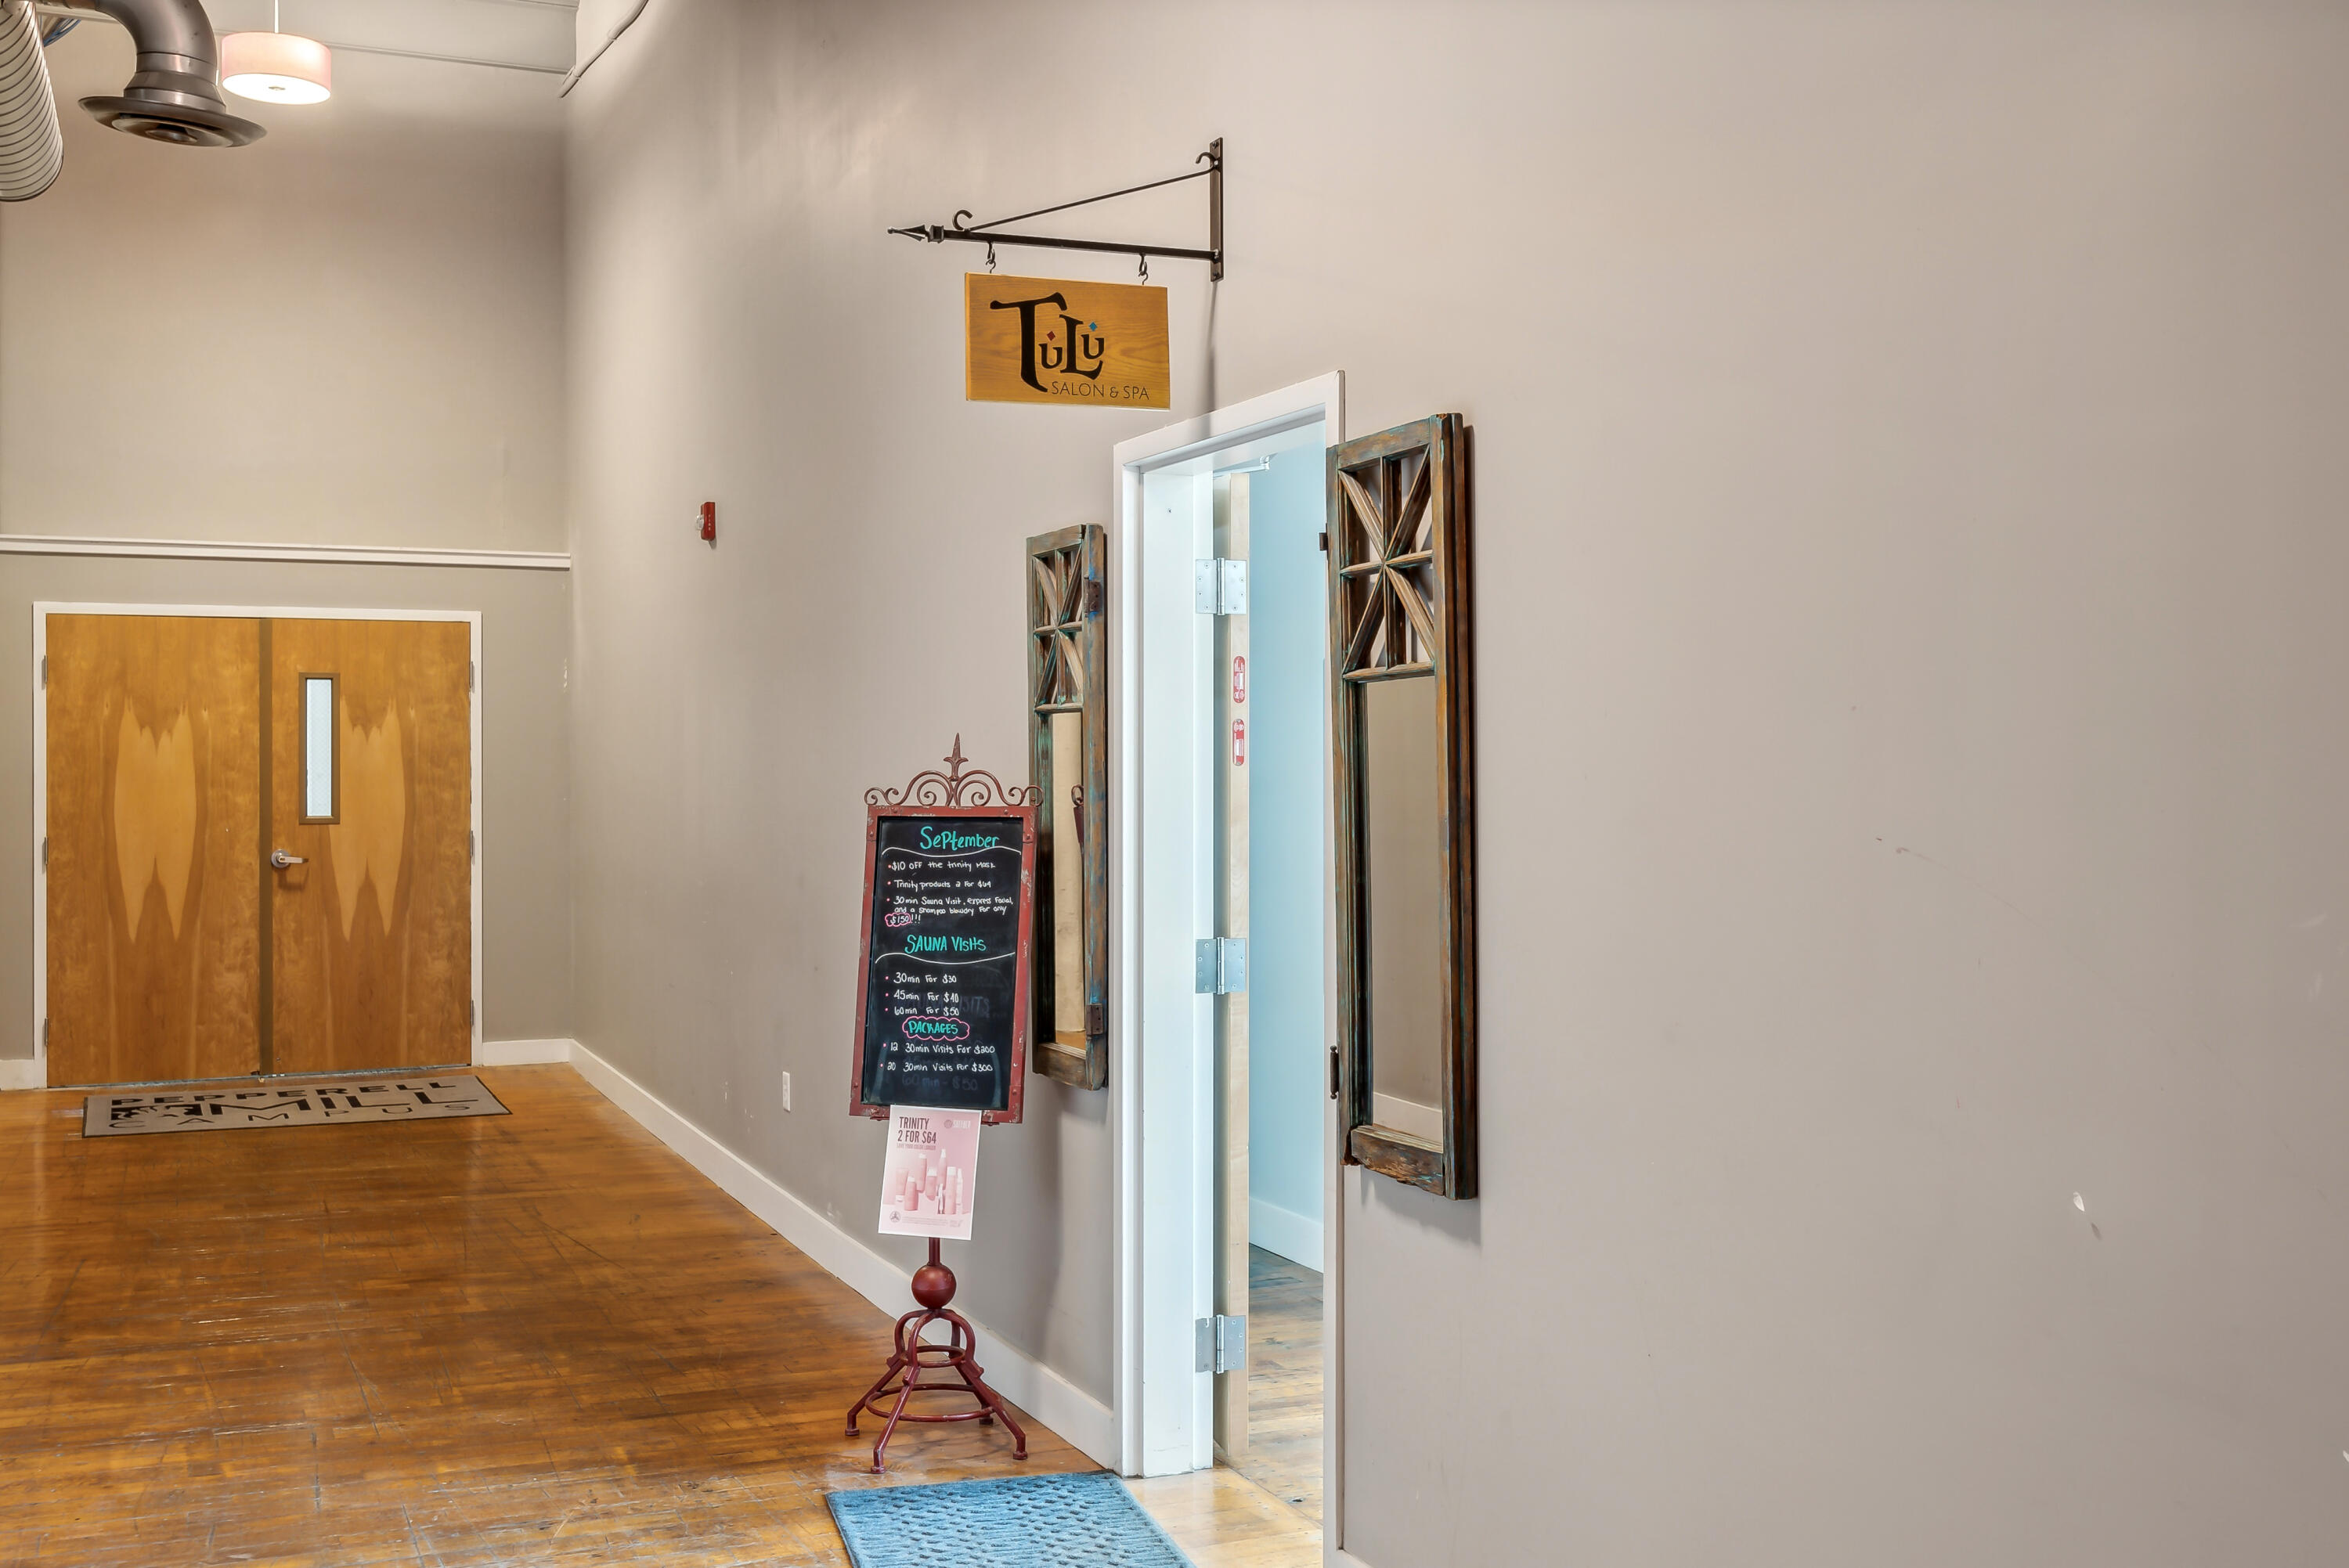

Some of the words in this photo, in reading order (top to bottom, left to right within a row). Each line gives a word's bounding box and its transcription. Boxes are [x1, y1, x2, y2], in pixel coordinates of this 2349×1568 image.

[1051, 380, 1104, 398] SALON
[1110, 387, 1119, 398] &
[1123, 385, 1149, 400] SPA
[892, 861, 906, 871] $10
[947, 860, 972, 872] trinity
[893, 879, 918, 892] Trinity
[919, 881, 951, 890] products
[977, 879, 991, 888] $64
[922, 896, 943, 905] Sauna
[993, 906, 1007, 915] only
[904, 934, 947, 953] SAUNA
[925, 975, 938, 983] For
[942, 974, 957, 984] $30
[927, 992, 940, 1001] For
[944, 992, 959, 1003] $40
[943, 1005, 959, 1016] $50
[908, 1020, 958, 1034] PACKAGES
[890, 1042, 898, 1051] 12
[933, 1045, 954, 1054] Visits
[957, 1044, 972, 1054] For
[974, 1045, 995, 1054] $200
[887, 1062, 896, 1071] 20
[933, 1062, 954, 1072] Visits
[972, 1062, 994, 1072] $300
[111, 1082, 456, 1105] PEPPERELL
[210, 1091, 478, 1116] MILL
[109, 1105, 470, 1128] CAMPUS
[899, 1116, 929, 1130] TRINITY
[897, 1130, 903, 1141] 2
[905, 1130, 920, 1143] FOR
